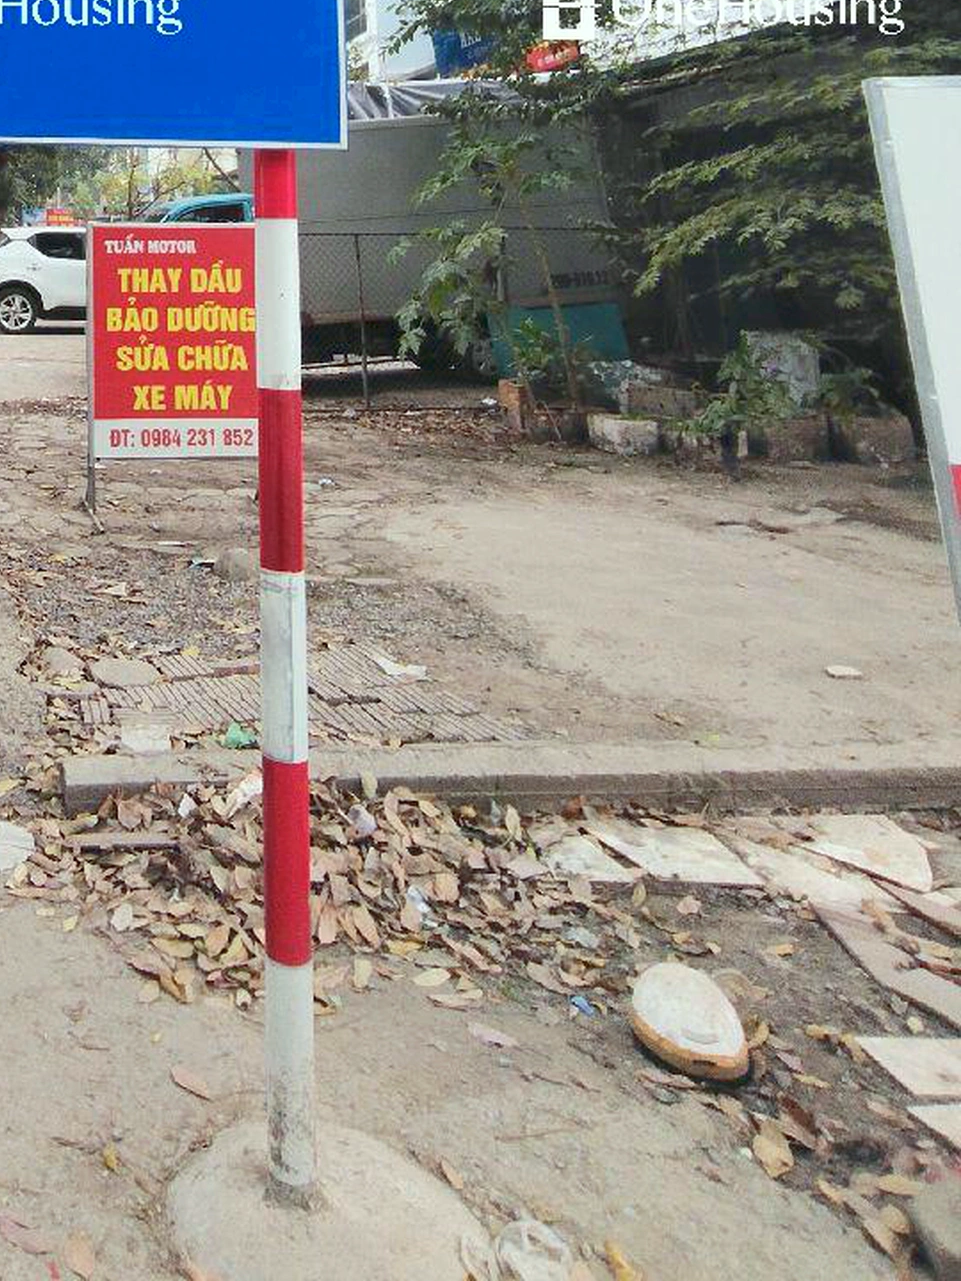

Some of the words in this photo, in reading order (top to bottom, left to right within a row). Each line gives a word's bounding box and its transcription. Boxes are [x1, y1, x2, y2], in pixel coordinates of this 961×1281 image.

[104, 233, 143, 255] TUẤN
[147, 239, 197, 255] MOTOR
[117, 268, 182, 294] THAY
[106, 297, 159, 332] BẢO
[167, 301, 256, 332] DƯỠNG
[116, 335, 170, 371] SỬA
[177, 339, 249, 371] CHỮA
[133, 384, 166, 411] XE
[174, 379, 233, 411] MÁY
[109, 429, 136, 448] ĐT:
[140, 428, 182, 448] 0984
[186, 428, 216, 447] 231
[223, 428, 254, 447] 852
